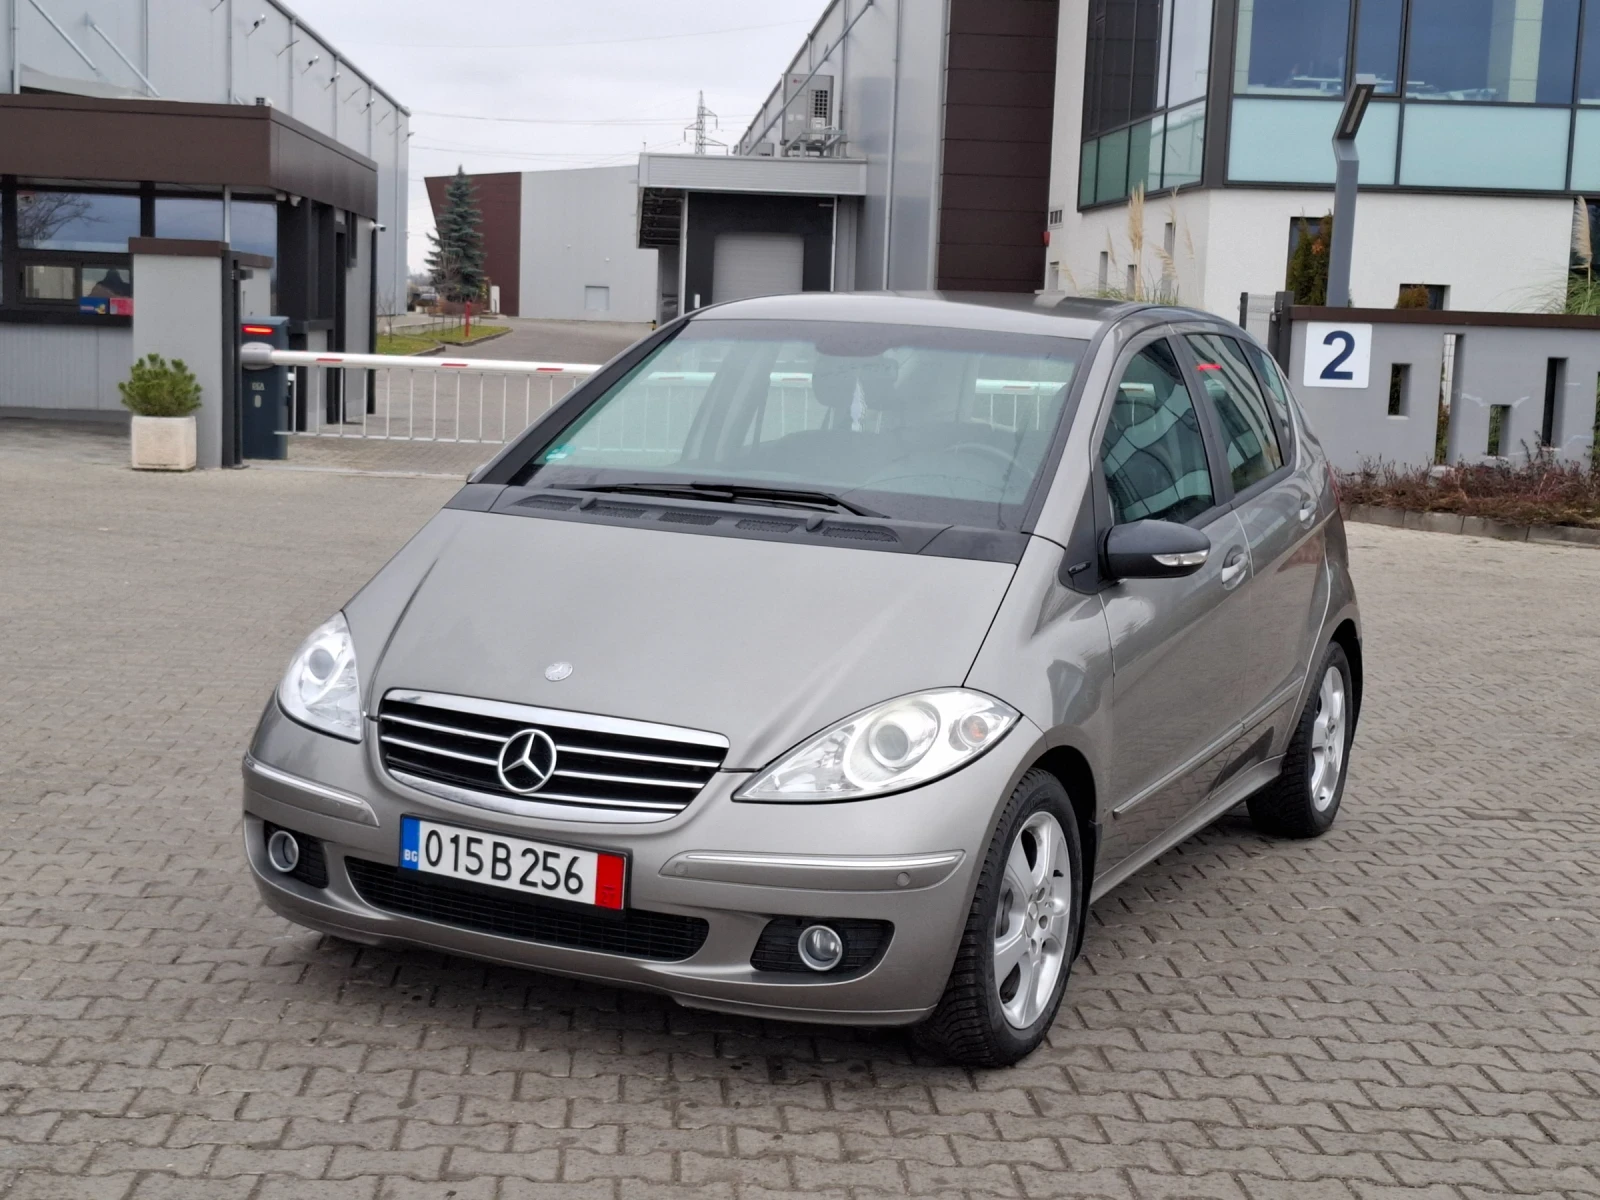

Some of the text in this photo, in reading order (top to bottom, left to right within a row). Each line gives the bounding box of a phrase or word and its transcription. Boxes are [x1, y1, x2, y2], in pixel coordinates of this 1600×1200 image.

[1320, 330, 1355, 380] 2
[404, 849, 418, 863] BG
[425, 829, 584, 895] 015B256
